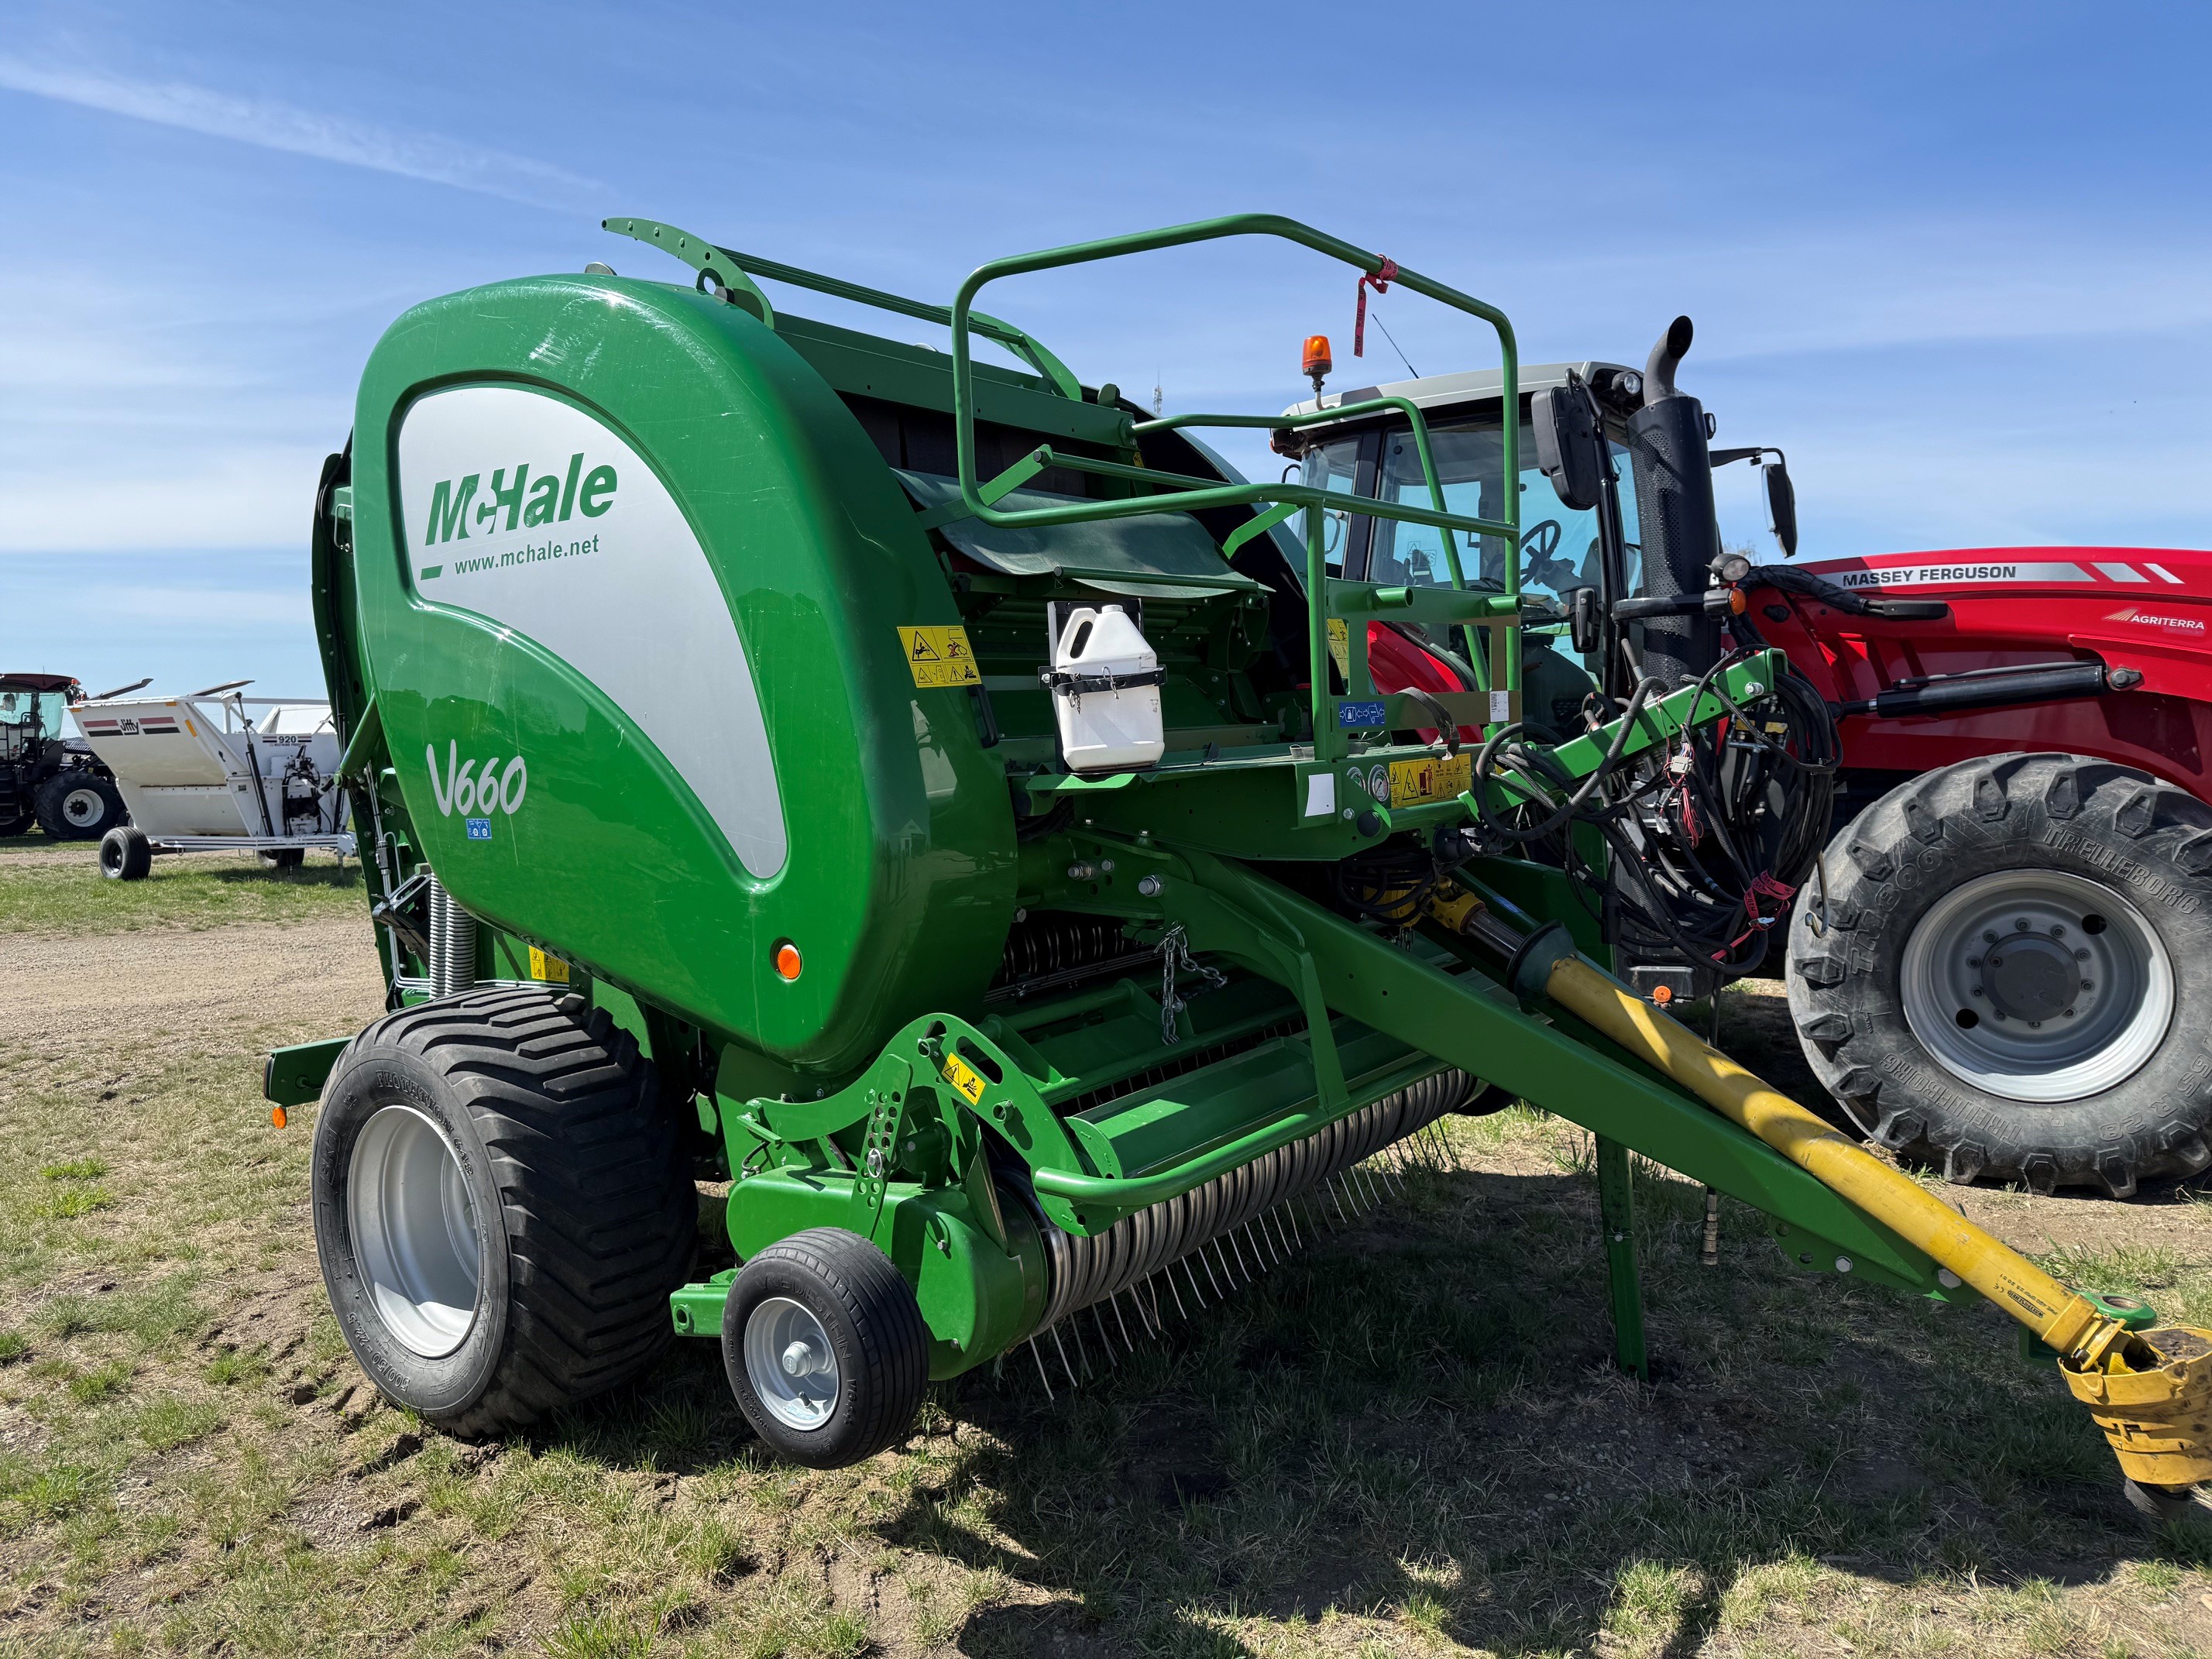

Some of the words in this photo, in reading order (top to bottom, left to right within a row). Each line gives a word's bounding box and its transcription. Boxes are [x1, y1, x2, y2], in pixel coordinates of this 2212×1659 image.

[424, 452, 618, 546] McHale
[455, 534, 599, 575] www.mchale.net
[1843, 569, 1914, 587] MASSEY
[1919, 566, 2016, 582] FERGUSON
[2131, 615, 2205, 630] AGRITERRA
[120, 719, 139, 735] Jiffy
[426, 738, 527, 817] V660
[2043, 823, 2202, 915] TRELLEBORG
[376, 1070, 455, 1136] FLOTATION
[1879, 1053, 2022, 1148] TRELLEBORG
[2100, 1111, 2147, 1142] 28
